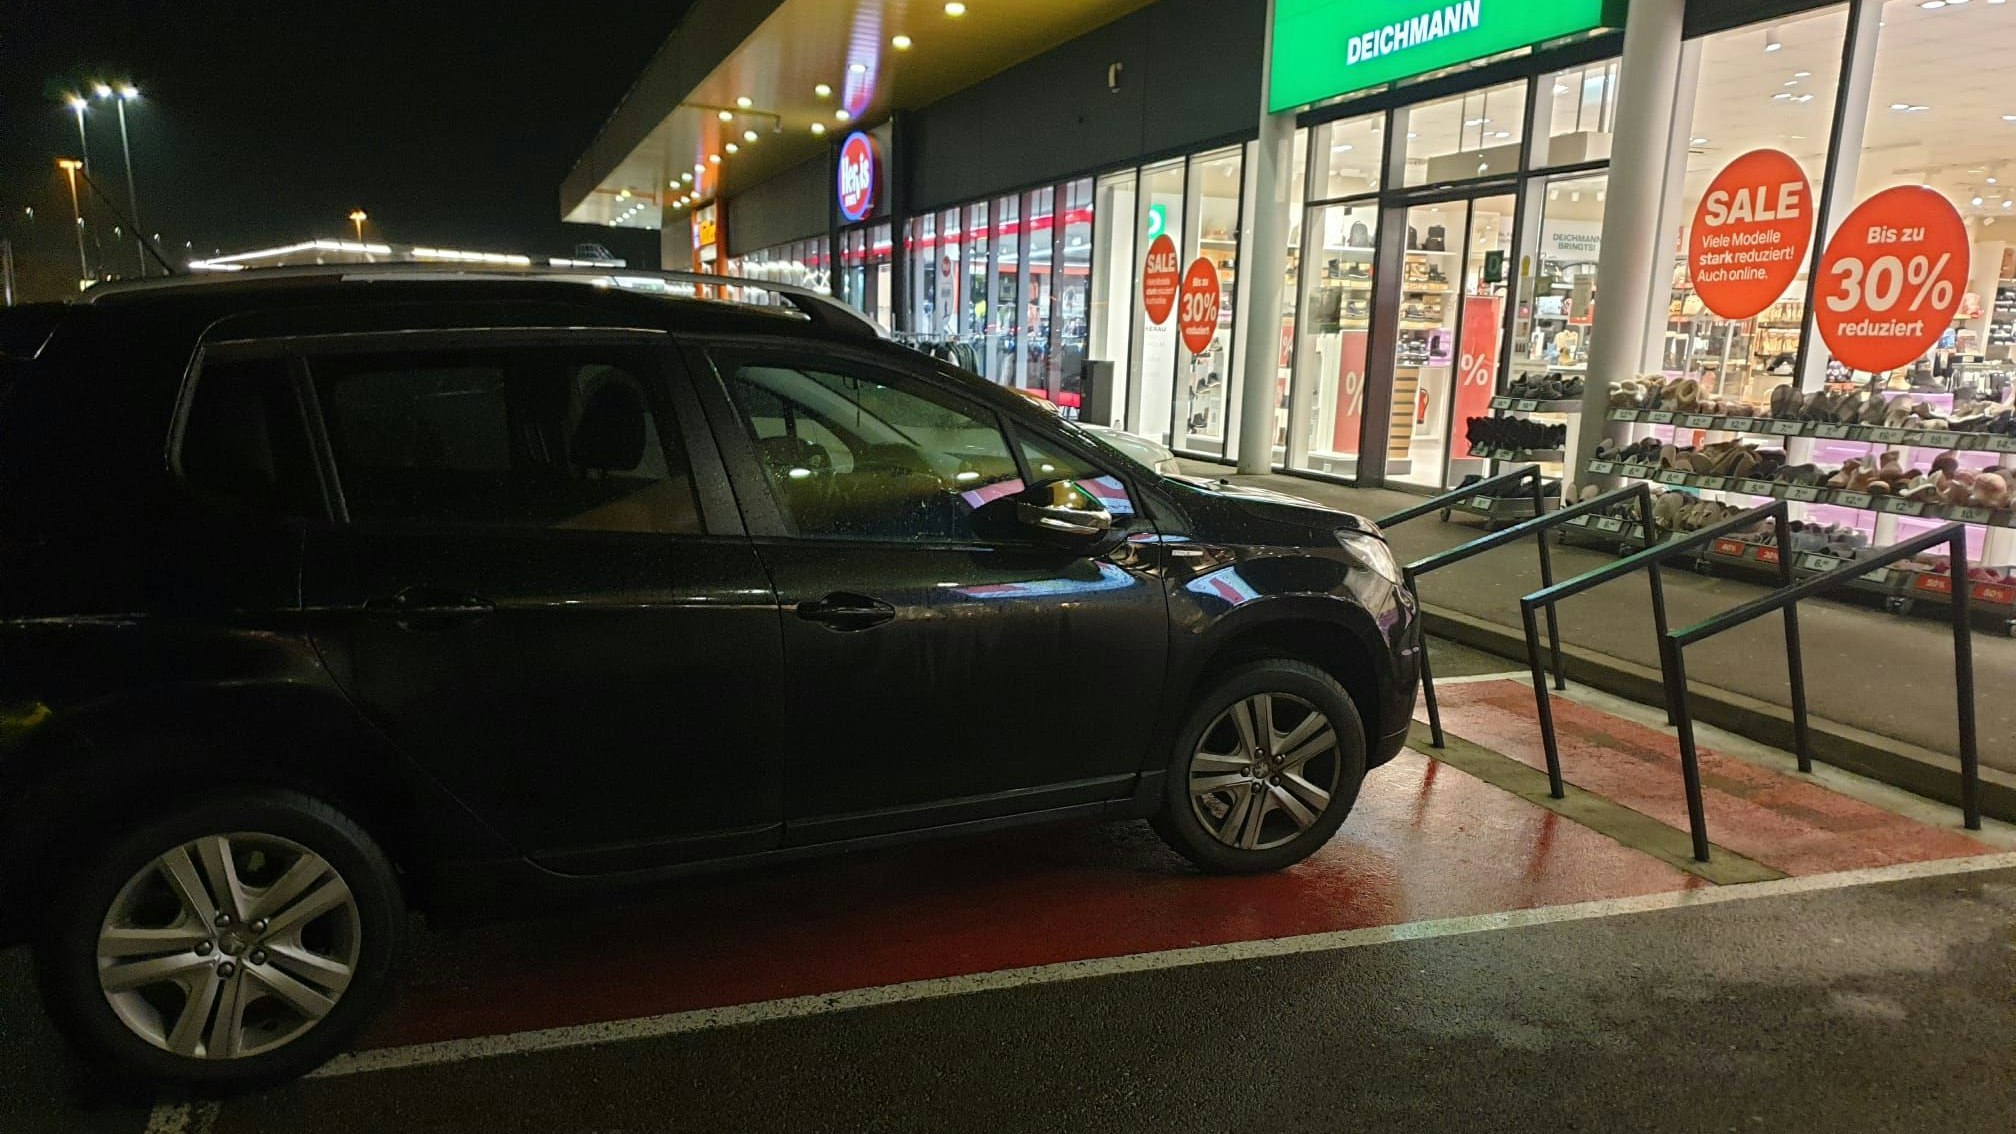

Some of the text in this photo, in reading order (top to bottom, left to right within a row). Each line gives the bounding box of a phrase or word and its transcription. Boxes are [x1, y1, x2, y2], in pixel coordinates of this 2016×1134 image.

[1346, 0, 1481, 66] DEICHMANN
[1704, 180, 1804, 227] SALE
[1702, 229, 1781, 248] Viele Modelle
[1866, 225, 1925, 244] Bis zu
[1147, 252, 1176, 274] SALE
[1699, 245, 1795, 265] stark reduziert!
[1697, 265, 1769, 282] Auch online.
[1826, 252, 1953, 312] 30%
[1182, 292, 1217, 322] 30%
[1837, 318, 1924, 337] reduziert
